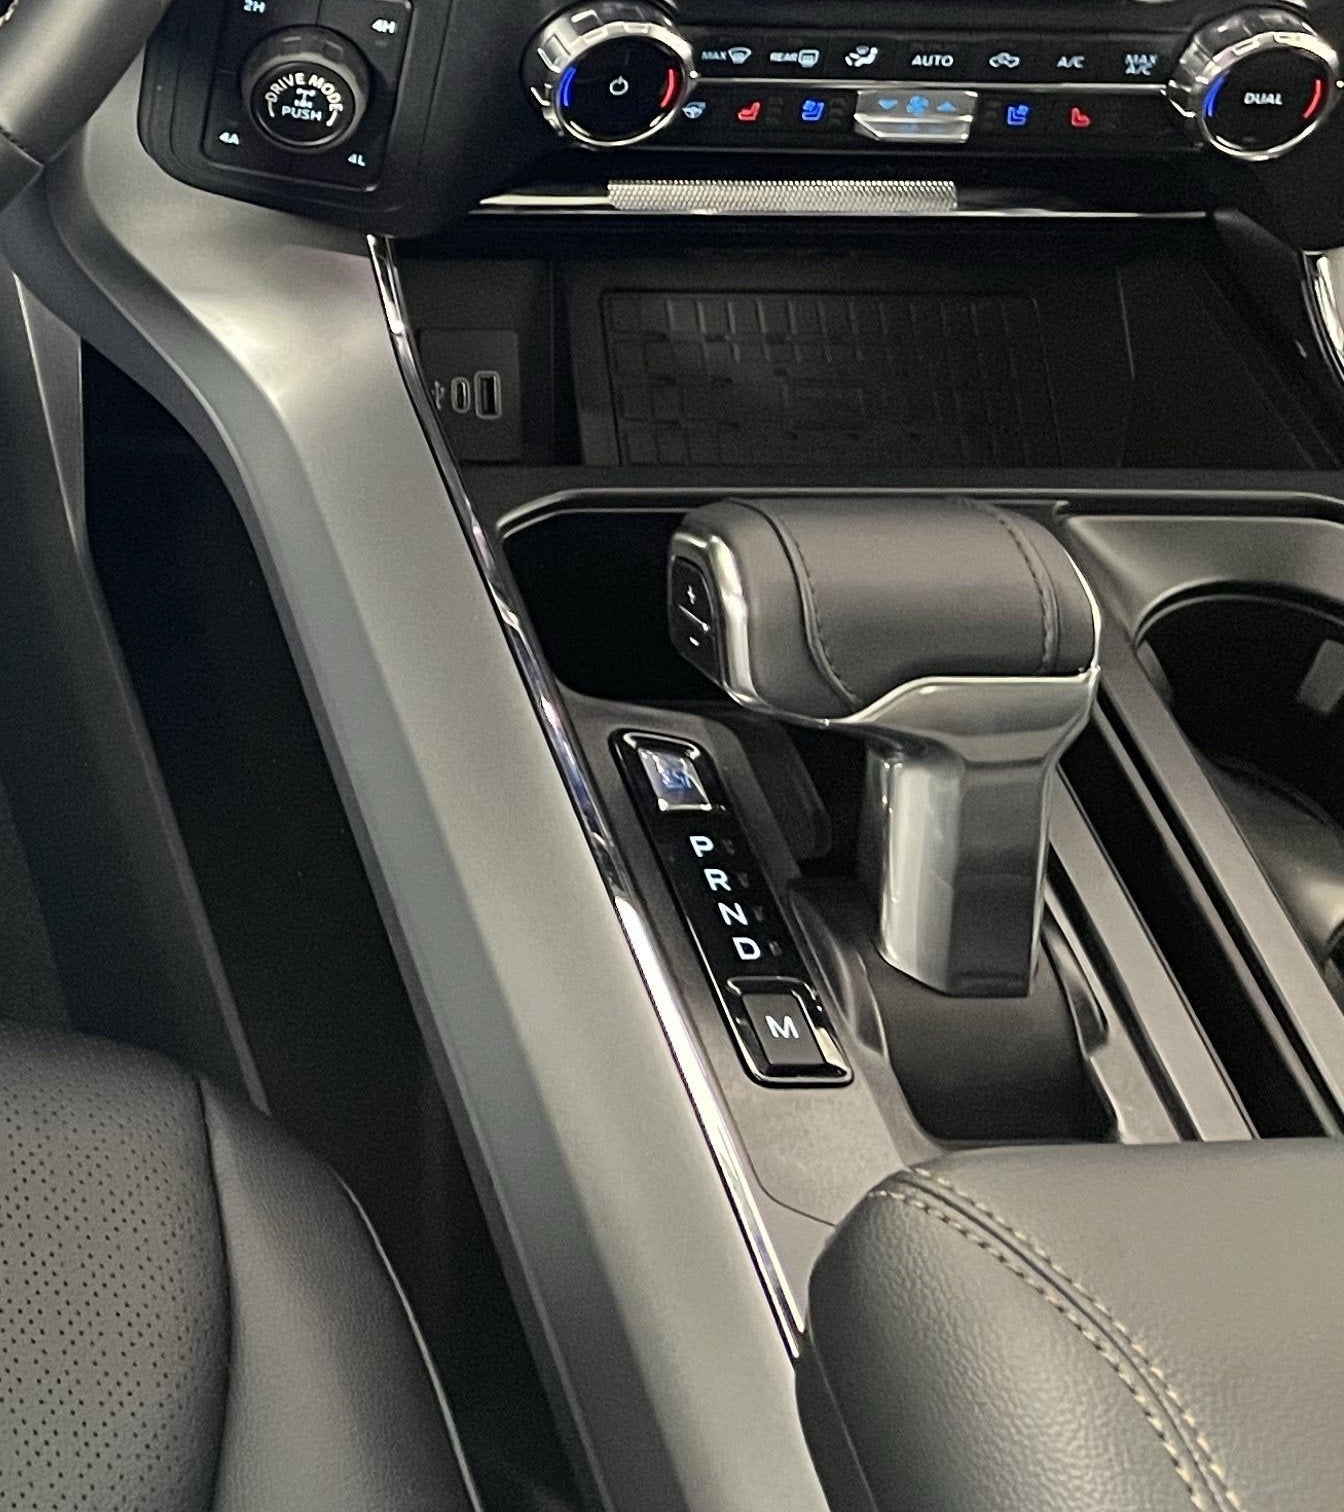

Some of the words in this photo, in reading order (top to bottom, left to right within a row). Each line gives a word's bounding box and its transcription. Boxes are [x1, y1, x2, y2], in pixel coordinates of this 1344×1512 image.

[243, 0, 266, 13] 2H
[371, 19, 396, 34] 4H
[912, 54, 953, 67] AUTO
[1057, 55, 1084, 68] A/C
[1125, 54, 1157, 65] MAX
[265, 72, 305, 103] DRIVE
[308, 74, 343, 112] MODE
[1244, 92, 1283, 106] DUAL
[281, 105, 322, 121] PUSH
[218, 131, 240, 145] 4A
[347, 152, 365, 167] 4L
[689, 835, 714, 858] P
[703, 868, 732, 892] R
[717, 902, 749, 926] N
[732, 936, 762, 961] D
[764, 1014, 800, 1040] M
